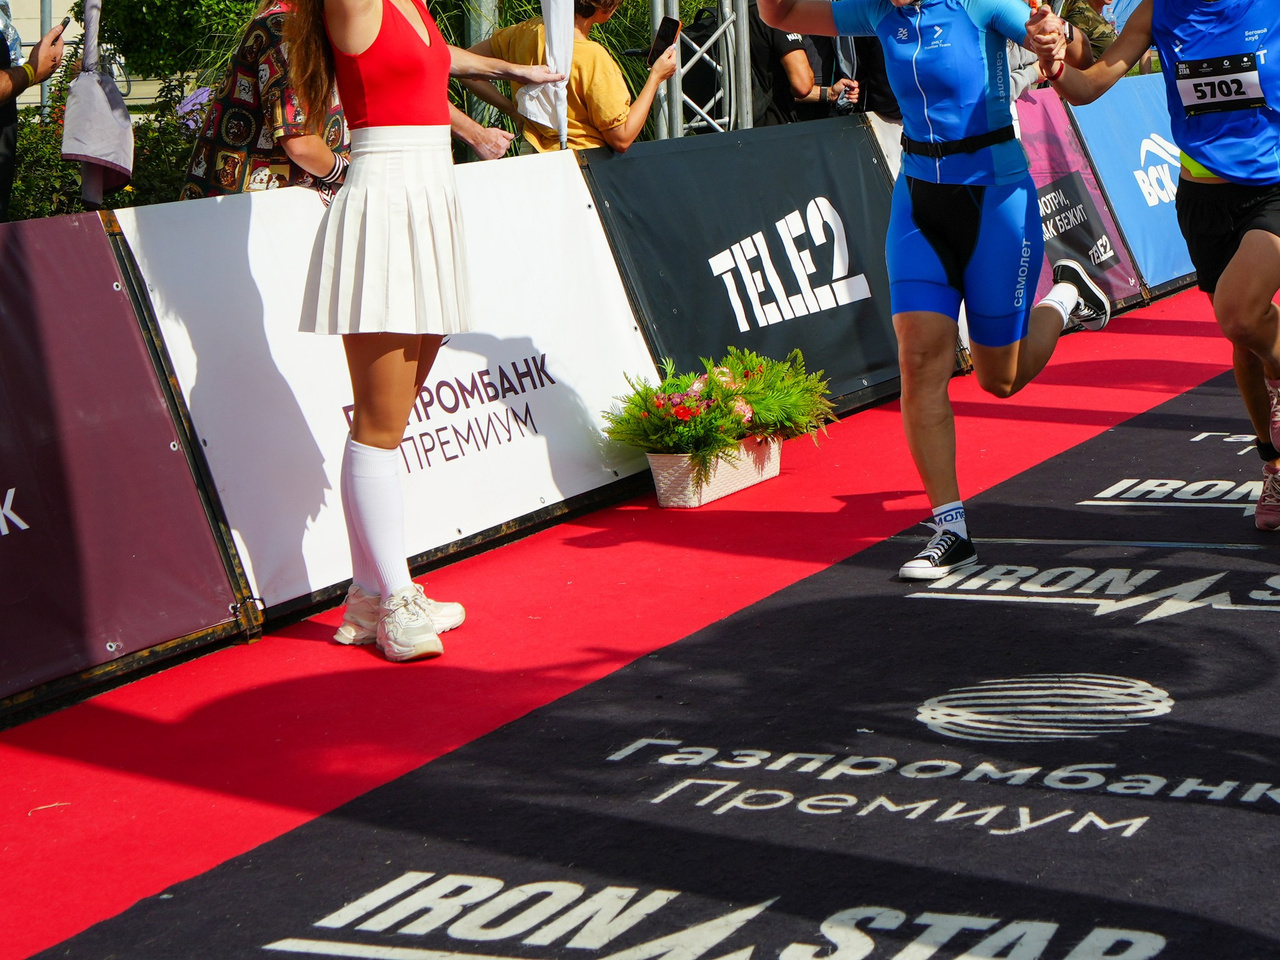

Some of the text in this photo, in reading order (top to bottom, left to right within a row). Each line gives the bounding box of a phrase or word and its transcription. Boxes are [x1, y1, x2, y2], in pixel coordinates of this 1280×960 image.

[996, 51, 1006, 104] самолет
[1192, 78, 1247, 100] 5702
[1038, 188, 1071, 218] МОТРИ,
[1133, 163, 1178, 208] ВСК
[1041, 203, 1088, 242] АК БЕЖИТ
[707, 196, 872, 333] TELE2
[1013, 237, 1032, 308] самолет
[1088, 234, 1115, 266] TELE2
[342, 352, 556, 432] ГПРОМБАНК
[400, 401, 539, 474] ПРЕМИУМ
[1094, 479, 1263, 501] IRON
[926, 565, 1161, 596] IRON
[649, 778, 1152, 838] Премиум
[314, 871, 684, 951] IRON
